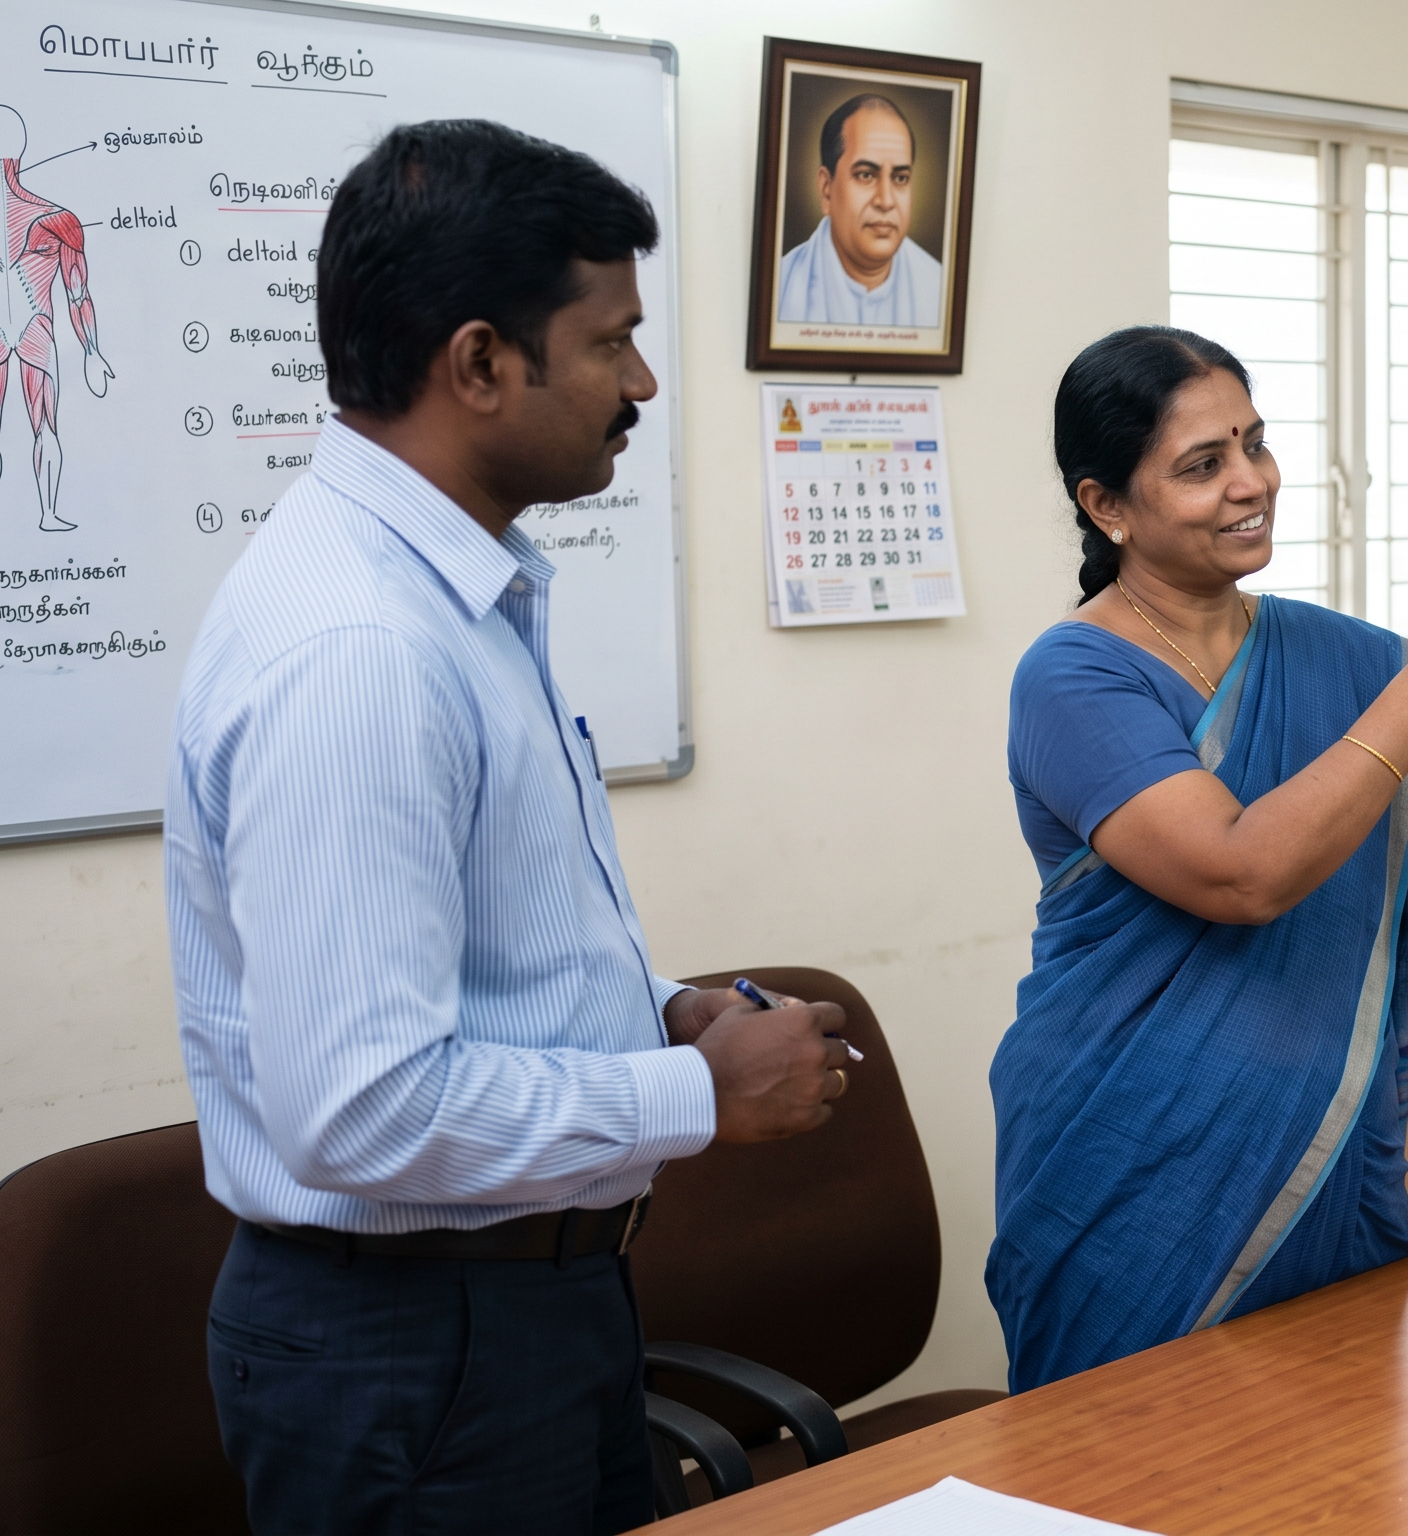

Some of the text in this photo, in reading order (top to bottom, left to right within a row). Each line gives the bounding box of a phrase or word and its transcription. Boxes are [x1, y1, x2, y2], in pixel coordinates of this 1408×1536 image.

[110, 205, 178, 230] deltoid
[227, 238, 298, 262] deltoid
[855, 458, 932, 473] 1 2 3 4
[785, 481, 937, 498] 5 6 7 8 9 10 11
[783, 503, 941, 522] 12 13 14 15 16 17 18
[785, 526, 944, 545] 19 20 21 22 23 24 25
[786, 550, 922, 569] 26 27 28 29 30 31
